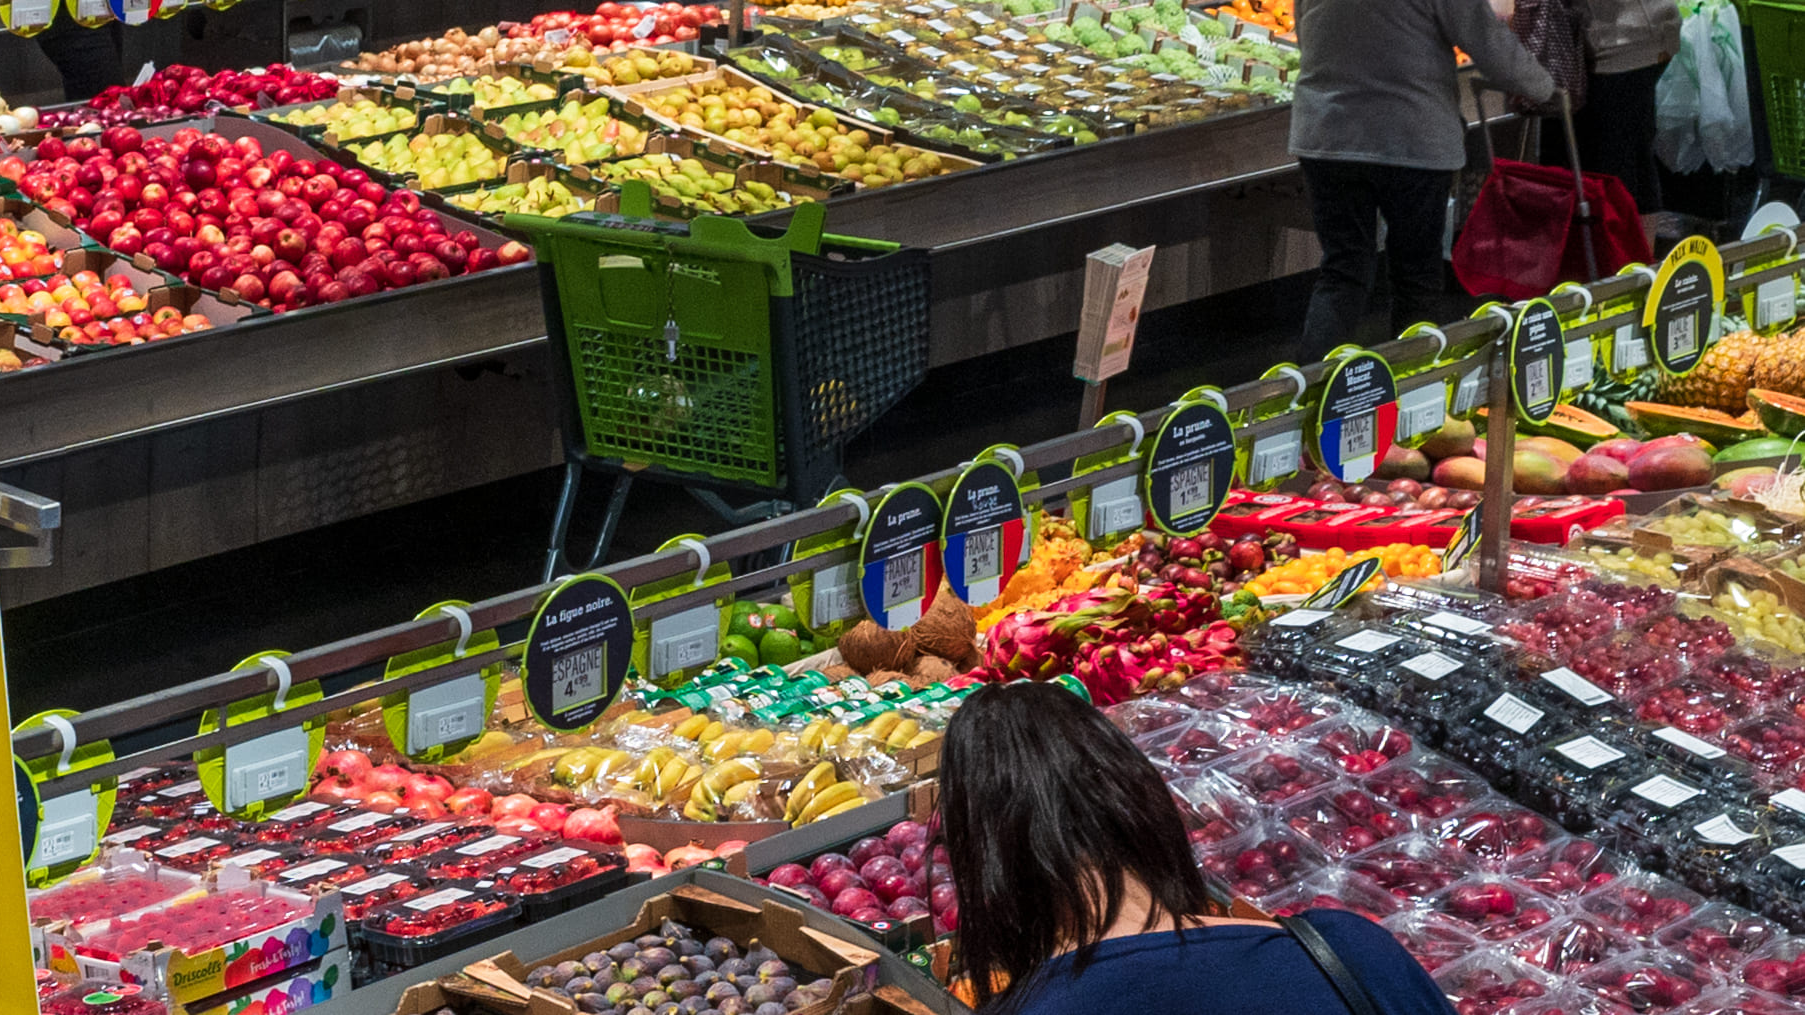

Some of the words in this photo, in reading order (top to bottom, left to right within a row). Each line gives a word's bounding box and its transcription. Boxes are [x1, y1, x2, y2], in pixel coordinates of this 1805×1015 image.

[1670, 245, 1685, 265] PRIX
[1345, 366, 1354, 377] Le
[1173, 426, 1184, 438] La
[1185, 419, 1213, 437] prune.
[967, 489, 976, 501] La
[977, 486, 1000, 500] prune.
[887, 515, 897, 526] La
[898, 508, 922, 525] prune.
[546, 614, 558, 628] La
[559, 605, 584, 623] figue
[585, 596, 614, 613] noire.
[173, 959, 222, 987] Driscoll's
